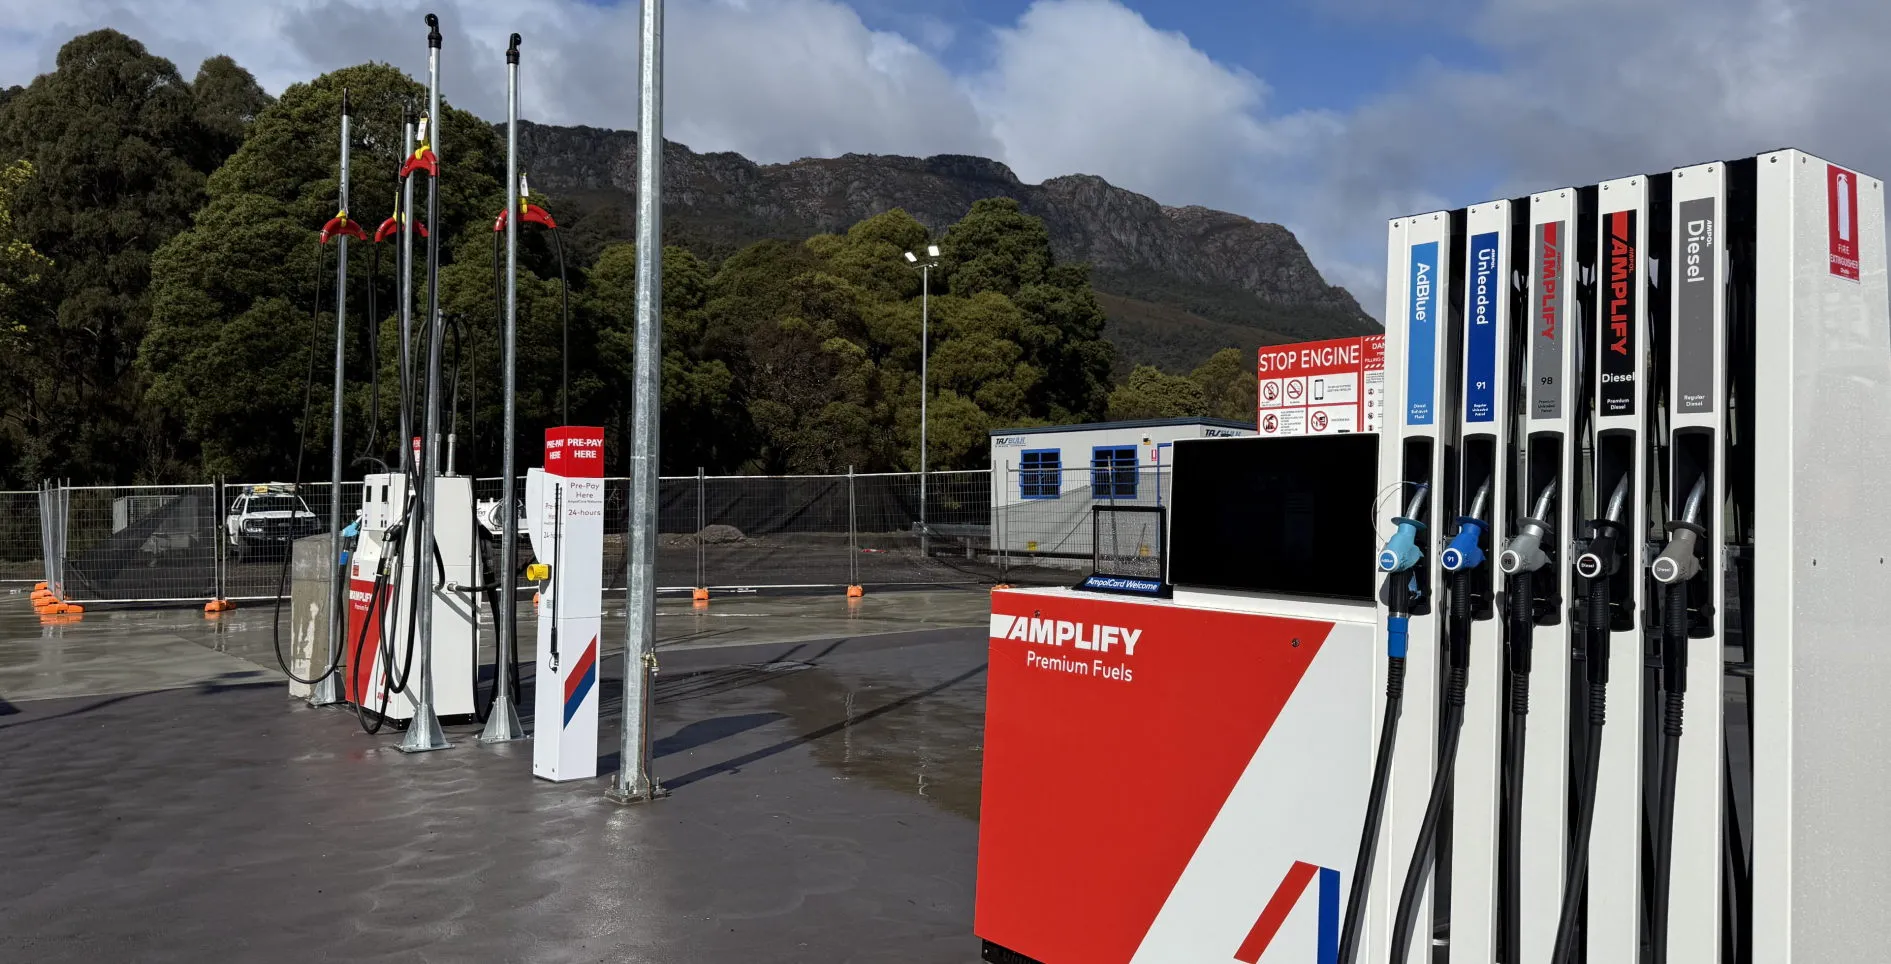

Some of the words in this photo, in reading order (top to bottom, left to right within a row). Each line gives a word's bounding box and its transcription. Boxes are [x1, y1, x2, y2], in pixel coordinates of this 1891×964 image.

[1687, 219, 1704, 282] Diesel
[1476, 248, 1490, 325] Unleaded
[1541, 242, 1556, 340] AMPLIFY
[1610, 237, 1628, 355] AMPLIFY
[1260, 351, 1296, 372] STOP
[1301, 345, 1359, 368] ENGINE
[1476, 381, 1486, 390] 91
[1540, 376, 1553, 385] 98
[1602, 371, 1635, 382] Diesel
[546, 439, 564, 448] PRE-PAY
[568, 438, 602, 446] PRE-PAY
[574, 450, 596, 458] HERE
[1086, 577, 1126, 588] AmpolCard
[1126, 580, 1157, 590] Welcome
[1008, 616, 1142, 656] AMPLIFY
[1026, 650, 1088, 675] Premium
[1093, 660, 1133, 682] Fuels
